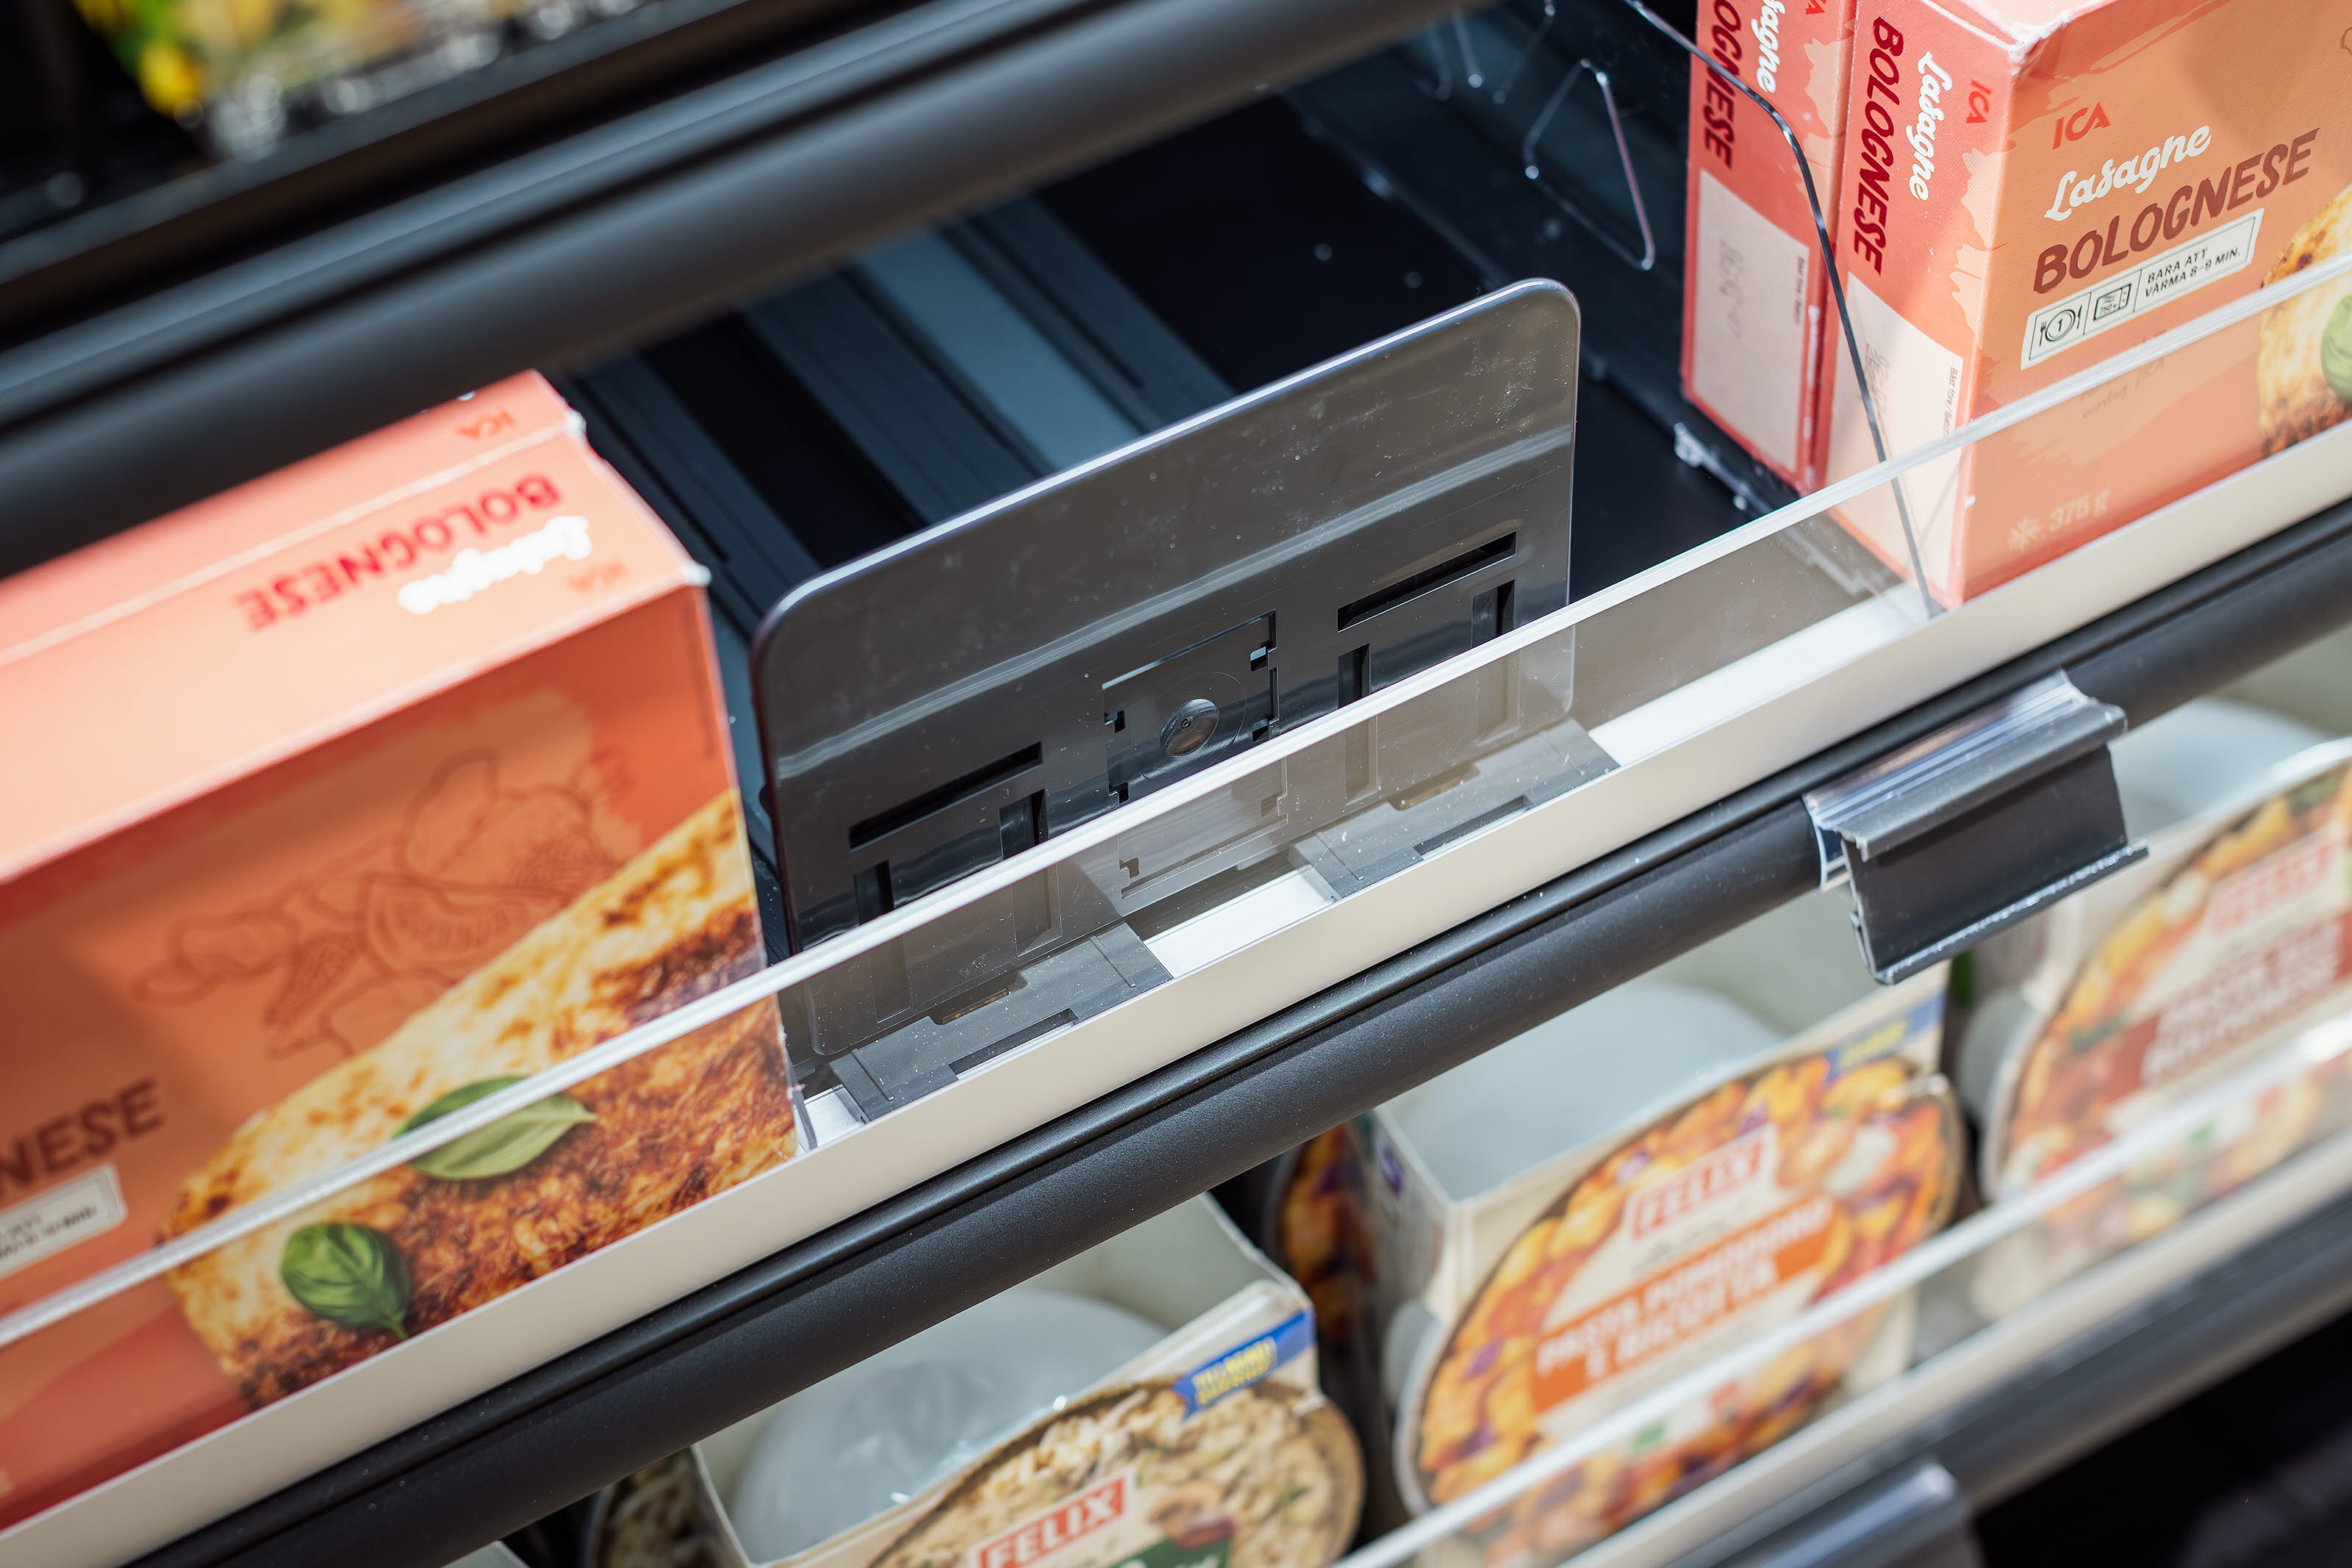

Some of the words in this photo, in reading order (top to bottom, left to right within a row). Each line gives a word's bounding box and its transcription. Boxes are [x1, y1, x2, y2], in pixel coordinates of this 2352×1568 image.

[1854, 16, 1904, 276] BOLOGNESE
[1905, 51, 1953, 201] Lasagne
[1965, 79, 1992, 123] ICA
[2051, 102, 2111, 149] ICA
[2033, 127, 2320, 294] BOLOGNESE
[2044, 125, 2212, 221] Lasagne
[2148, 261, 2180, 283] BARA
[2185, 248, 2209, 267] ATT
[2215, 248, 2241, 266] MIN.
[234, 473, 562, 632] BOLOGNESE
[987, 1484, 1119, 1568] FELIX
